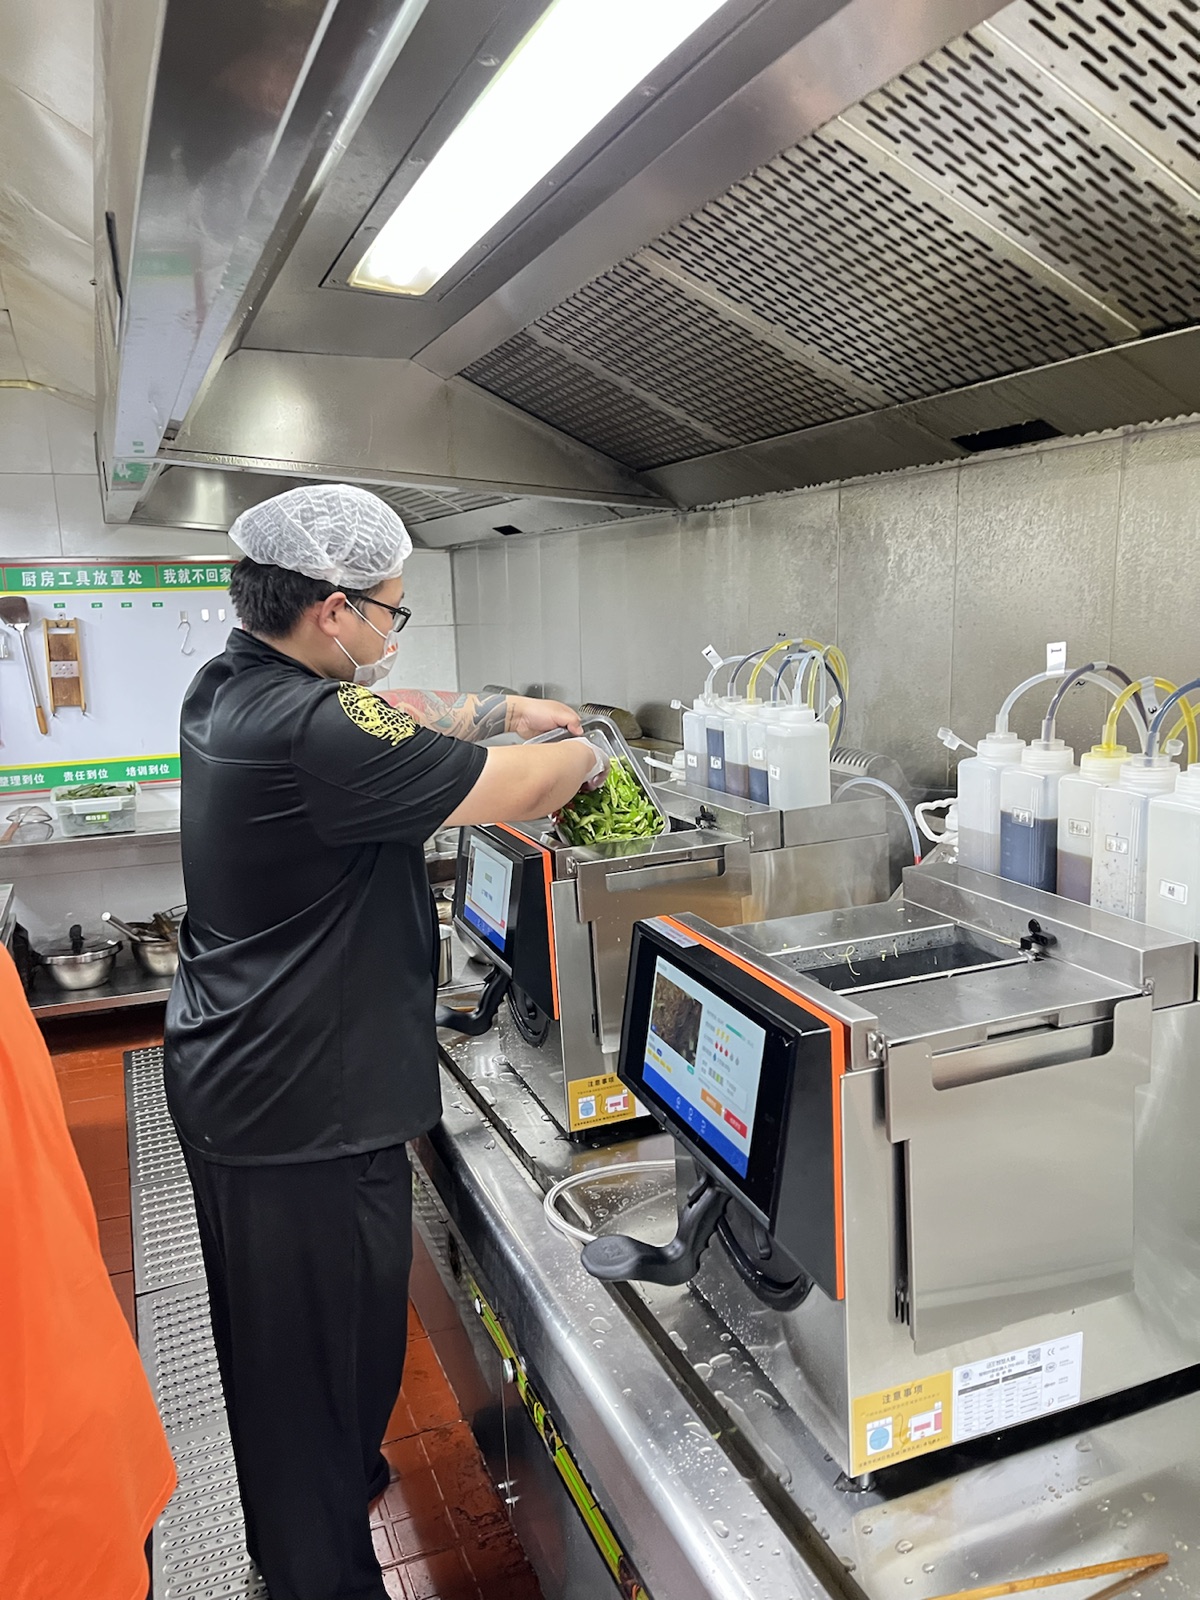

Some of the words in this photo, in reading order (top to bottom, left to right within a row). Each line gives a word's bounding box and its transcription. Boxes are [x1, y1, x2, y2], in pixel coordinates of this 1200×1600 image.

[22, 569, 142, 587] 厨房工具放置处
[163, 568, 231, 584] 我就不回家
[63, 768, 109, 782] 责任到位
[126, 763, 170, 777] 培训到位
[882, 1384, 923, 1404] 注意事项
